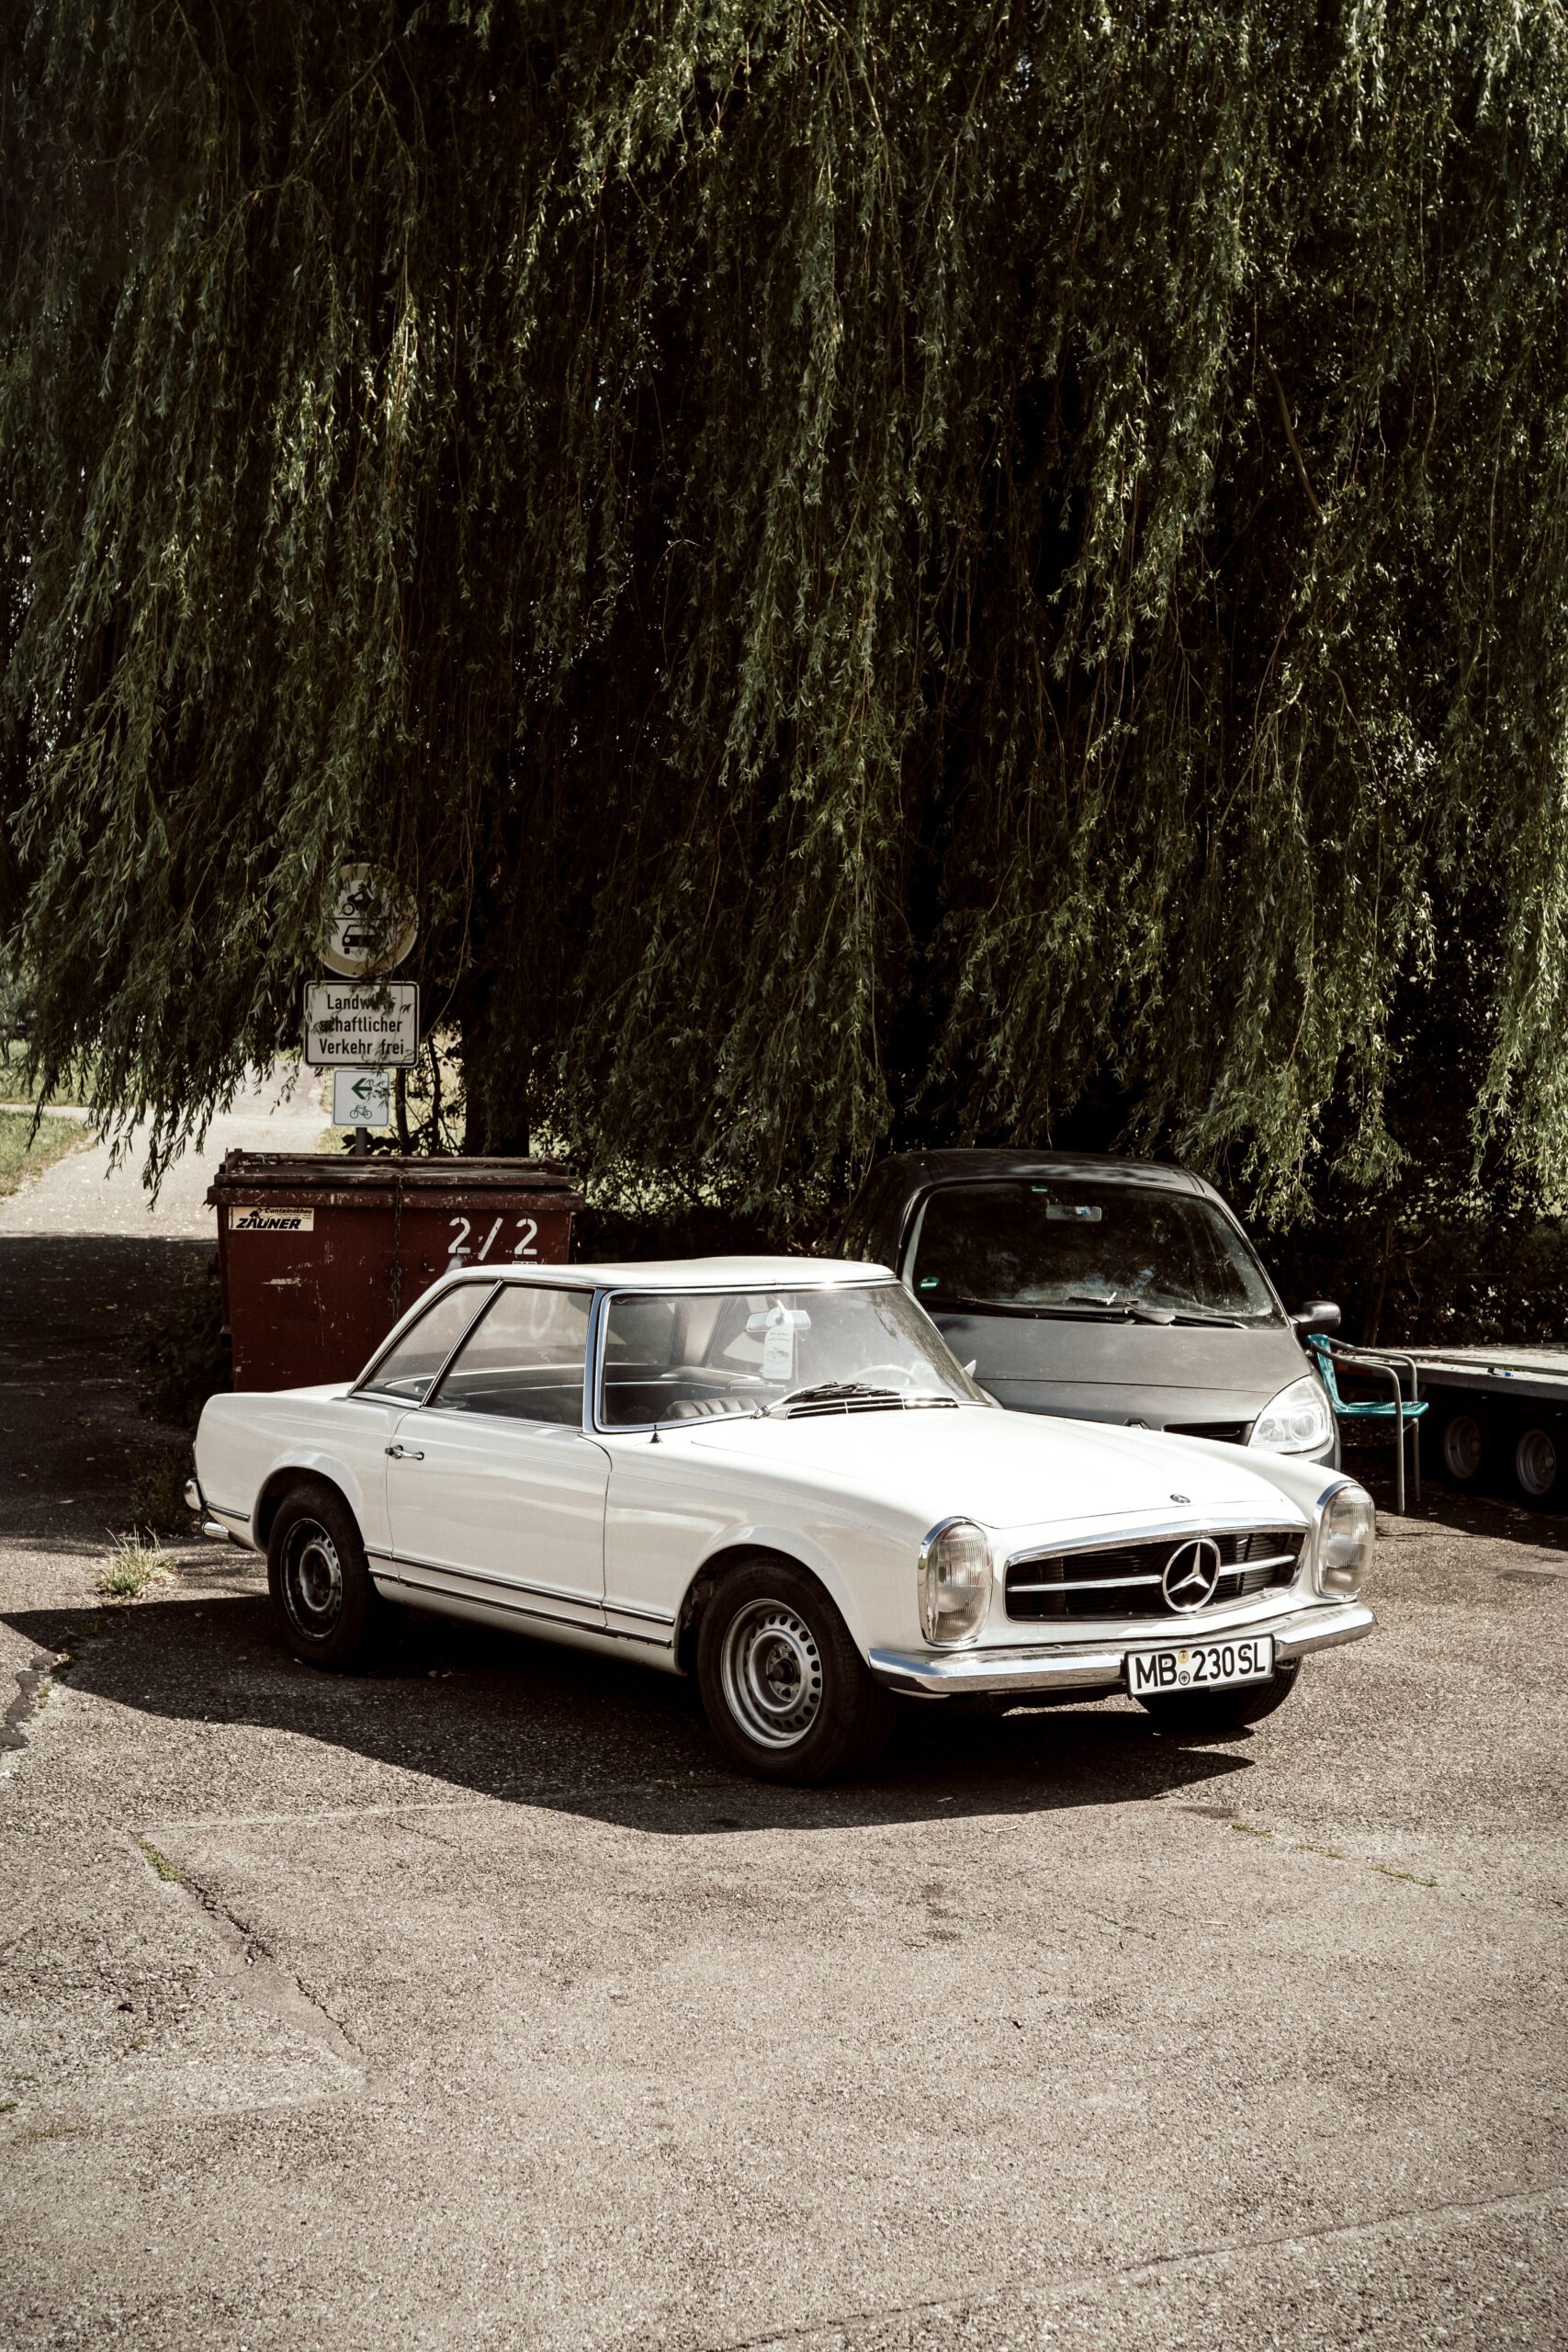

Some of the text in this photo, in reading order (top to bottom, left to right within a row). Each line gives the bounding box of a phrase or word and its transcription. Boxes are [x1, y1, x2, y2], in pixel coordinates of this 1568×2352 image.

[327, 994, 397, 1010] Landw-
[321, 1016, 403, 1032] haftlicher
[319, 1038, 404, 1055] Verkehr frei
[1135, 1653, 1177, 1689] MB
